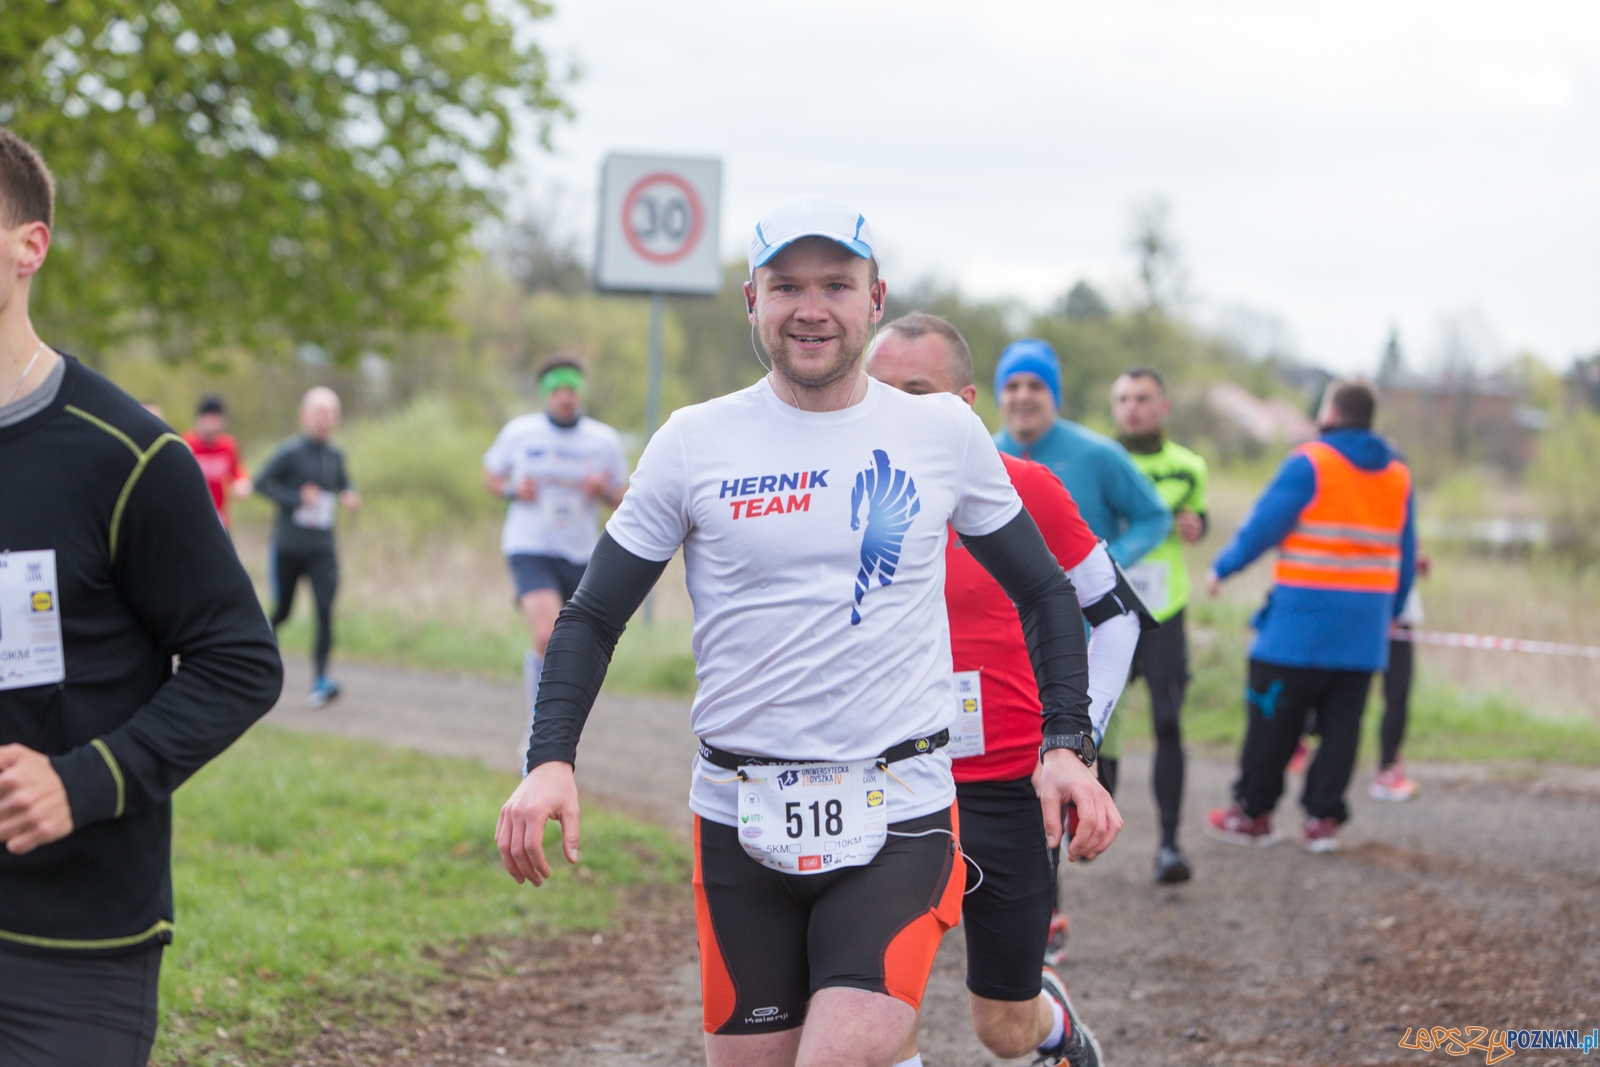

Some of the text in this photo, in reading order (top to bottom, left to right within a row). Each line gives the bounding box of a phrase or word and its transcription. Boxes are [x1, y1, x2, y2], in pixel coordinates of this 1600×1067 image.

[633, 196, 692, 242] 30
[719, 469, 830, 499] HERNIK
[729, 493, 811, 520] TEAM
[801, 766, 849, 776] UNIWERSYTECKA
[802, 774, 843, 785] ZADYSZKA IV
[785, 799, 843, 839] 518
[766, 844, 789, 854] 5KM
[837, 835, 862, 849] 10KM
[744, 1012, 789, 1024] Kalenji
